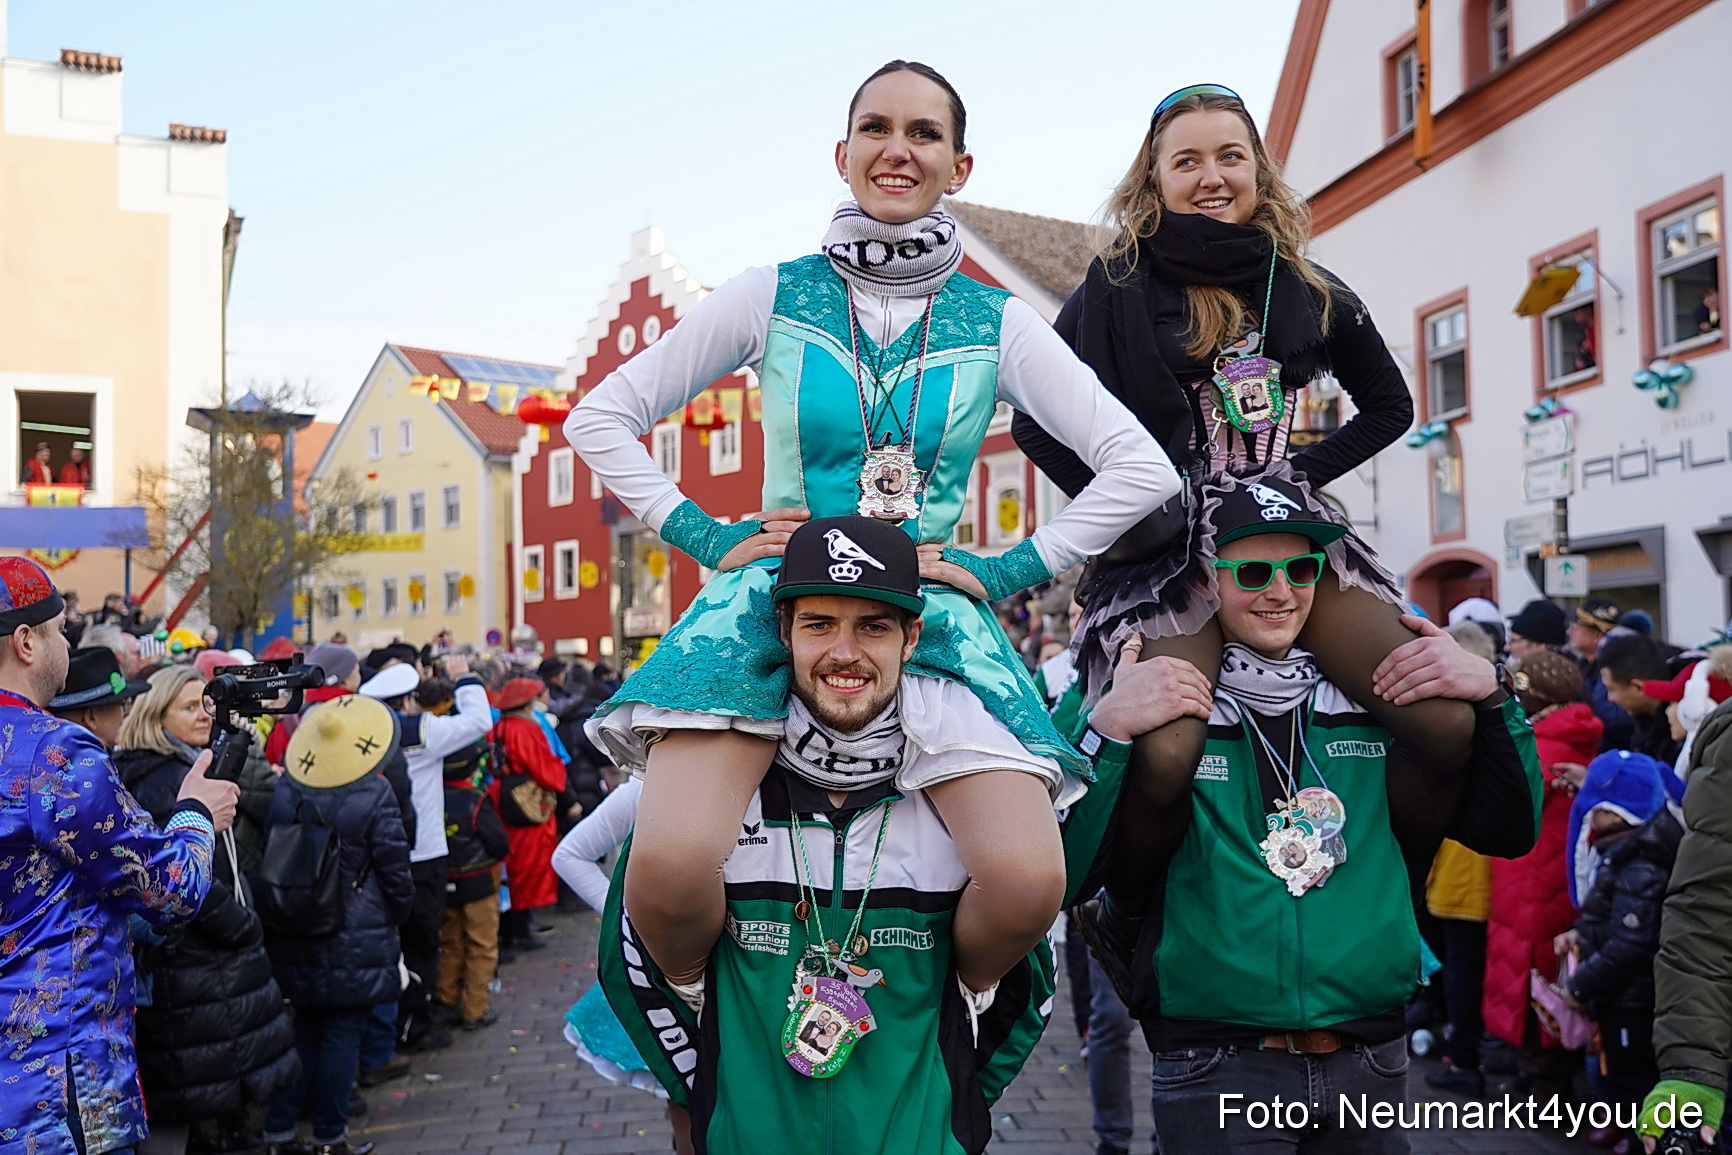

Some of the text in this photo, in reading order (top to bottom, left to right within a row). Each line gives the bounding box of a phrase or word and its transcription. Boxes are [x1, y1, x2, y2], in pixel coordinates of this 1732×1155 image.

[266, 679, 287, 688] RONIN
[1329, 742, 1383, 756] SCHIMMER
[737, 836, 768, 846] erima
[741, 922, 790, 935] SPORTS
[740, 932, 789, 946] Fashion
[873, 929, 933, 948] SCHIMMER
[829, 980, 842, 990] 35
[790, 1056, 808, 1073] 2023
